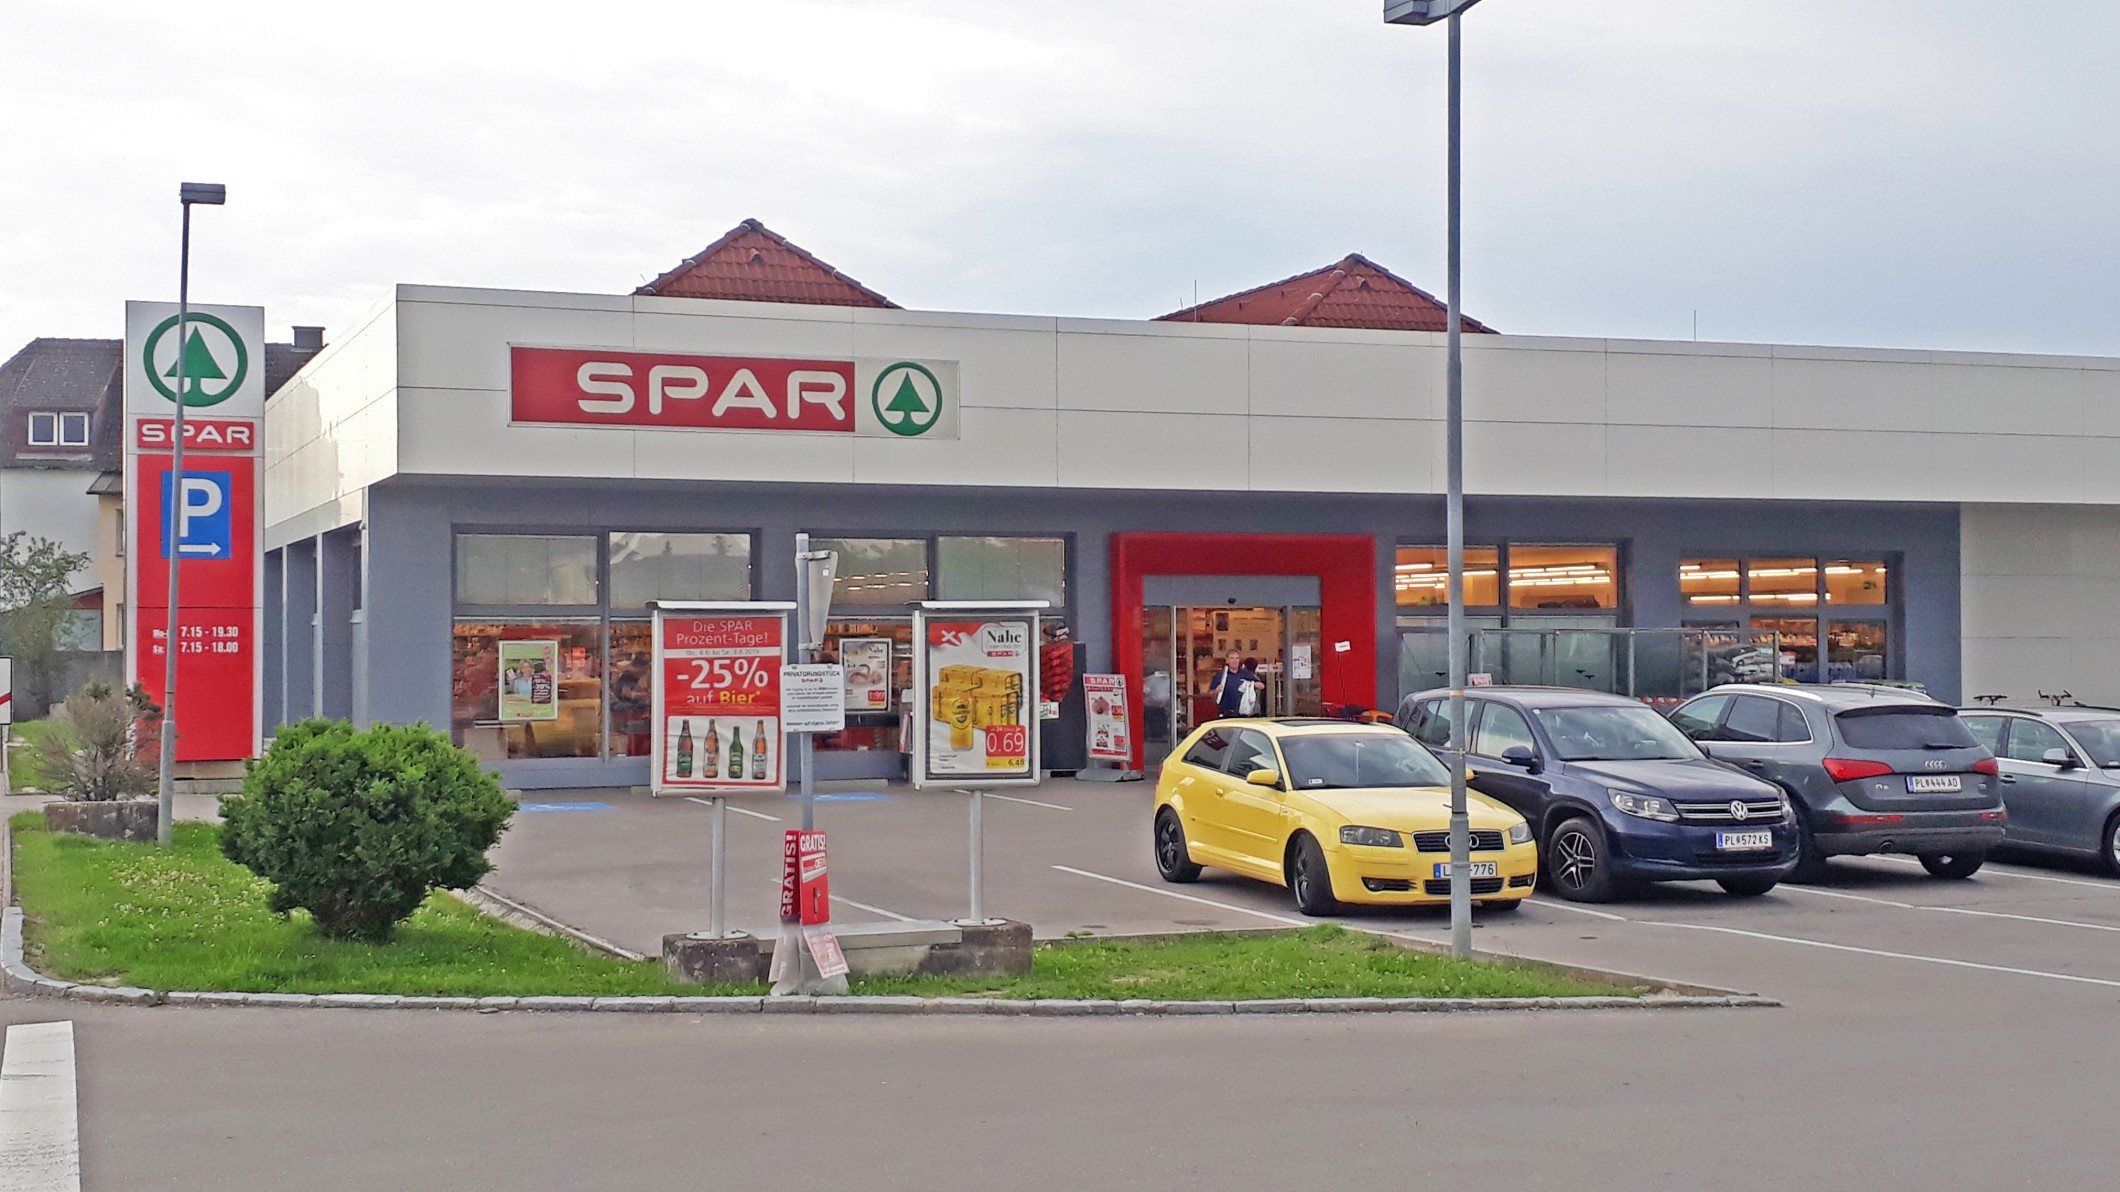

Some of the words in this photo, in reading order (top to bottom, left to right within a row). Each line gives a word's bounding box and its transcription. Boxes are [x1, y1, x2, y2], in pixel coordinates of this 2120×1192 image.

[576, 361, 847, 421] SPAR
[141, 424, 250, 444] SPAR
[180, 478, 223, 537] P
[180, 626, 202, 637] 7.15
[211, 626, 239, 637] 19.30
[693, 621, 715, 632] Die
[720, 620, 753, 631] SPAR
[180, 642, 202, 652] 7.15
[211, 642, 239, 652] 18.00
[676, 632, 768, 646] Prozent-Tage!
[677, 657, 769, 689] -25%
[1090, 677, 1115, 685] SPAR
[687, 690, 714, 704] auf
[987, 733, 1024, 752] 0.69
[800, 834, 826, 852] GRATIS!
[1725, 835, 1735, 845] PL
[781, 834, 797, 916] GRATIS!
